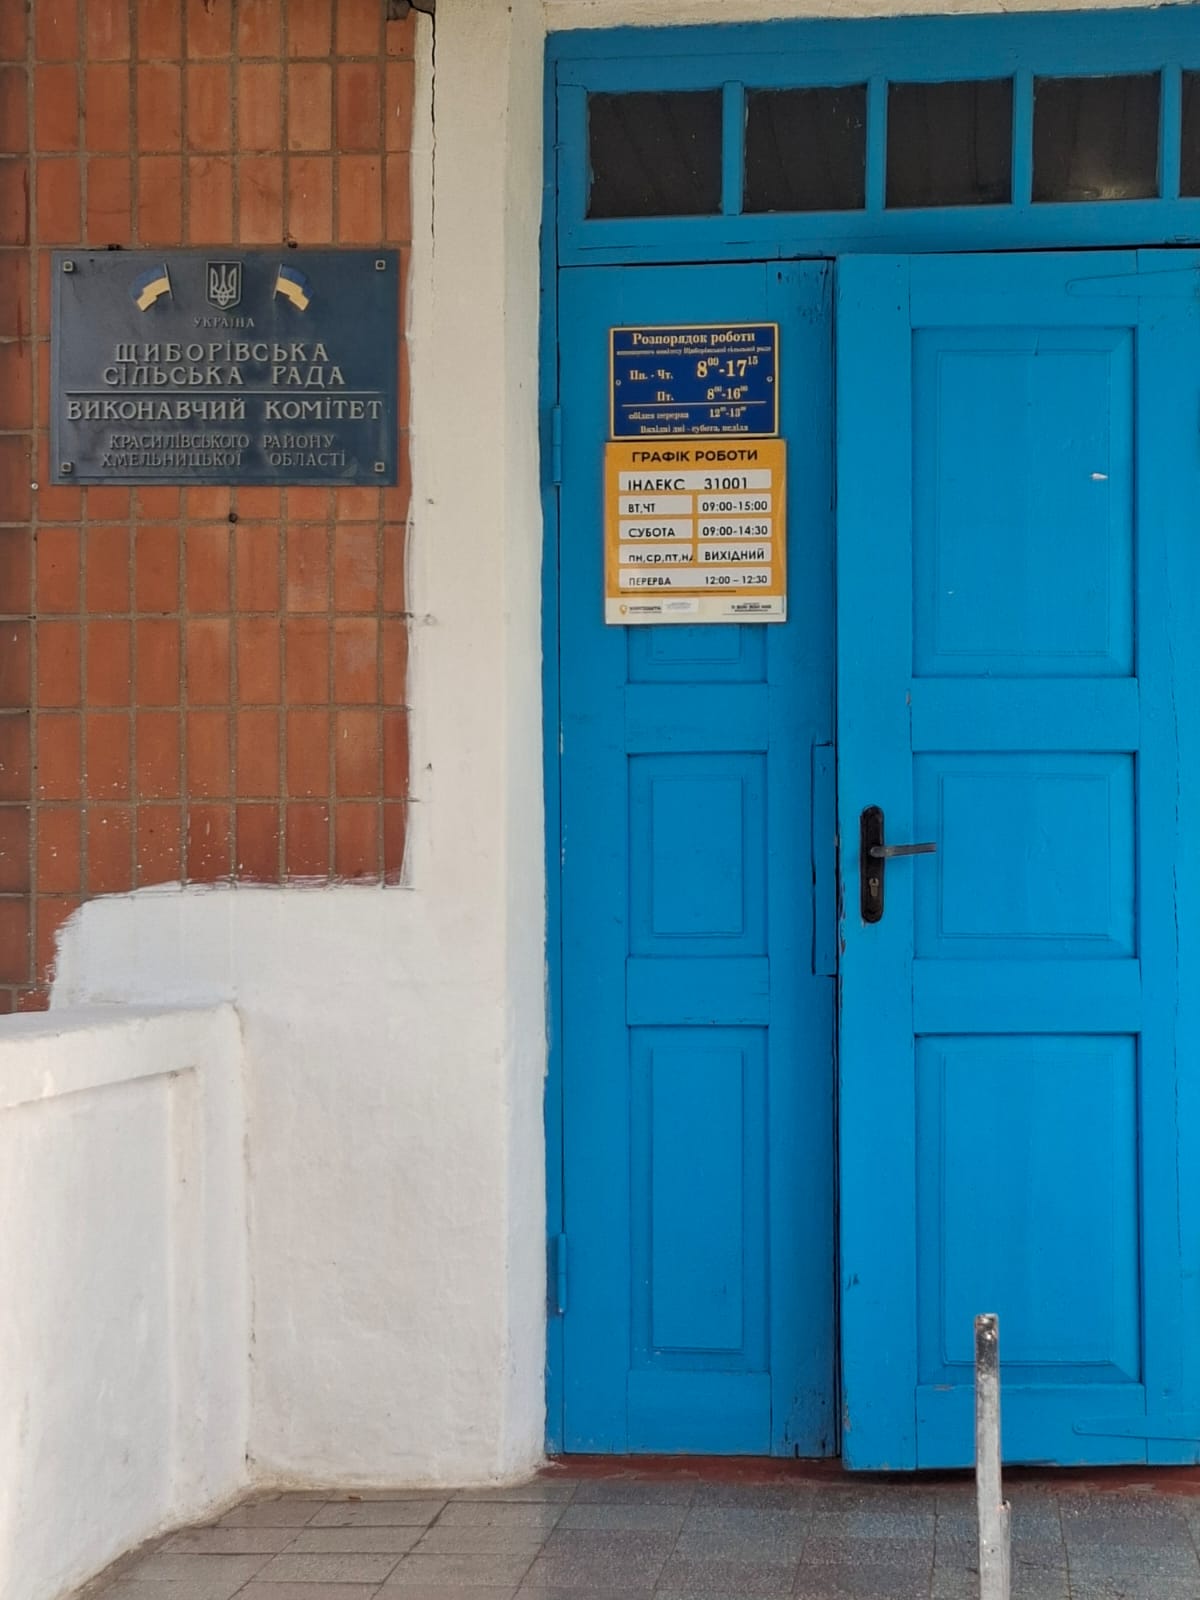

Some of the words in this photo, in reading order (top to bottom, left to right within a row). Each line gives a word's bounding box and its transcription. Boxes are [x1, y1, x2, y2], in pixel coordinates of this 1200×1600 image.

[193, 317, 255, 328] УКРАЇНА
[632, 332, 707, 345] Розпорядок
[711, 332, 755, 345] роботи
[114, 340, 330, 364] ЩИБОРІВСЬКА
[103, 366, 244, 386] СІЛЬСЬКА
[272, 366, 346, 388] РАДА
[658, 370, 673, 379] Чт.
[67, 398, 246, 421] ВИКОНАВЧИЙ
[265, 397, 382, 420] КОМІТЕТ
[110, 433, 249, 450] КРАСИЛІВСЬКОГО
[263, 432, 335, 449] РАЙОНУ
[102, 451, 241, 467] ХМЕЛЬНИЦЬКОЇ
[271, 450, 345, 466] ОБЛАСТІ
[632, 451, 689, 462] ГРАФІК
[695, 450, 758, 461] РОБОТИ
[704, 478, 747, 489] 31001
[702, 501, 768, 511] 09:00-15:00
[628, 528, 675, 537] СУБОТА
[702, 526, 768, 536] 09:00-14:30
[705, 548, 765, 561] ВИХІДНИЙ
[629, 577, 671, 586] ПЕРЕРВА
[705, 576, 730, 584] 12:00
